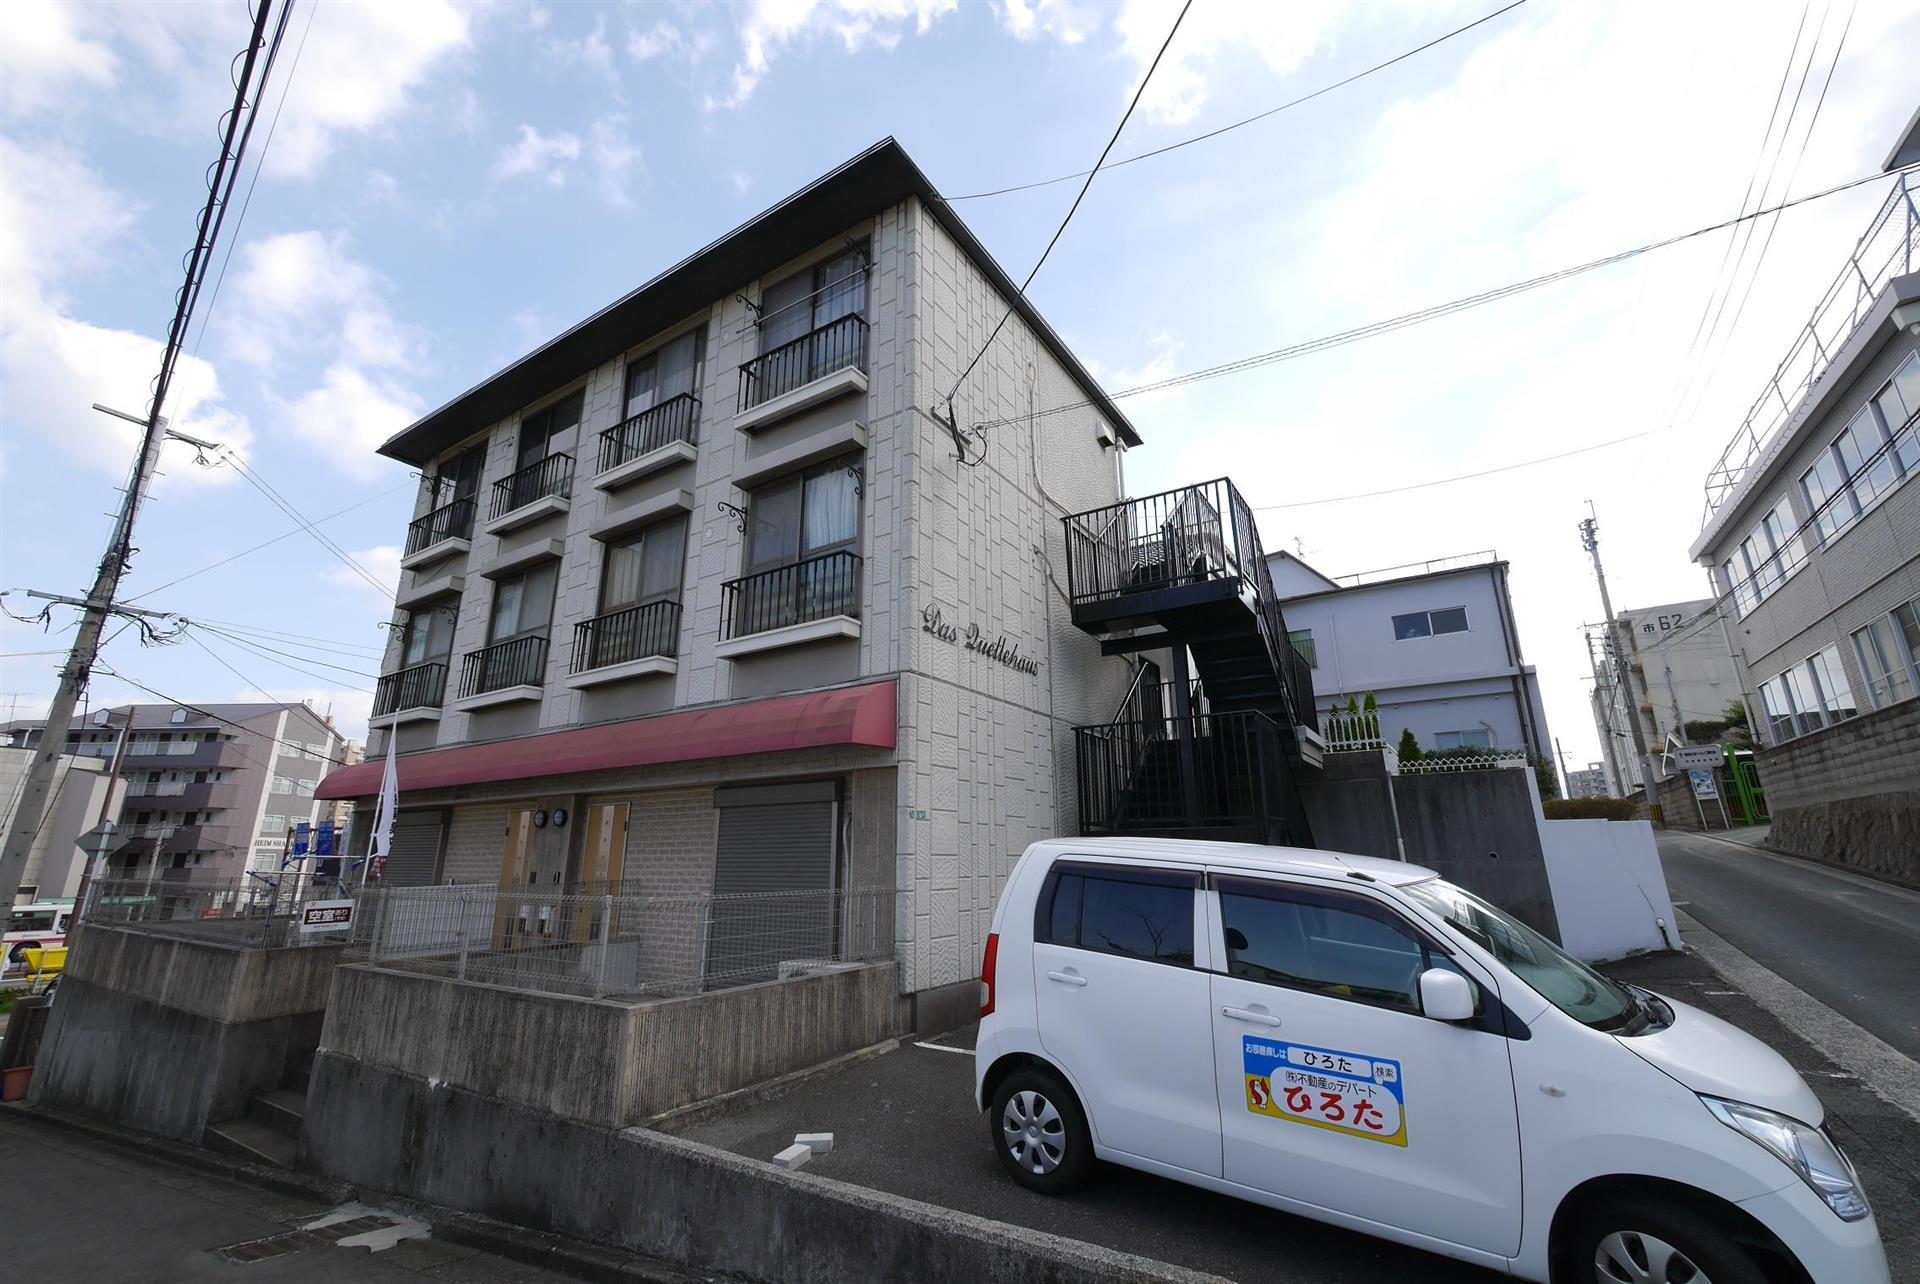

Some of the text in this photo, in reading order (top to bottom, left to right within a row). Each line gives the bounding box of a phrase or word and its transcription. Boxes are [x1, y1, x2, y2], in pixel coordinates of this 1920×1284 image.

[922, 602, 957, 643] Das
[1245, 1043, 1287, 1059] お部屋探しは
[1303, 1051, 1352, 1073] ひろた
[1375, 1066, 1394, 1078] 検索
[1283, 1086, 1384, 1130] ひろた
